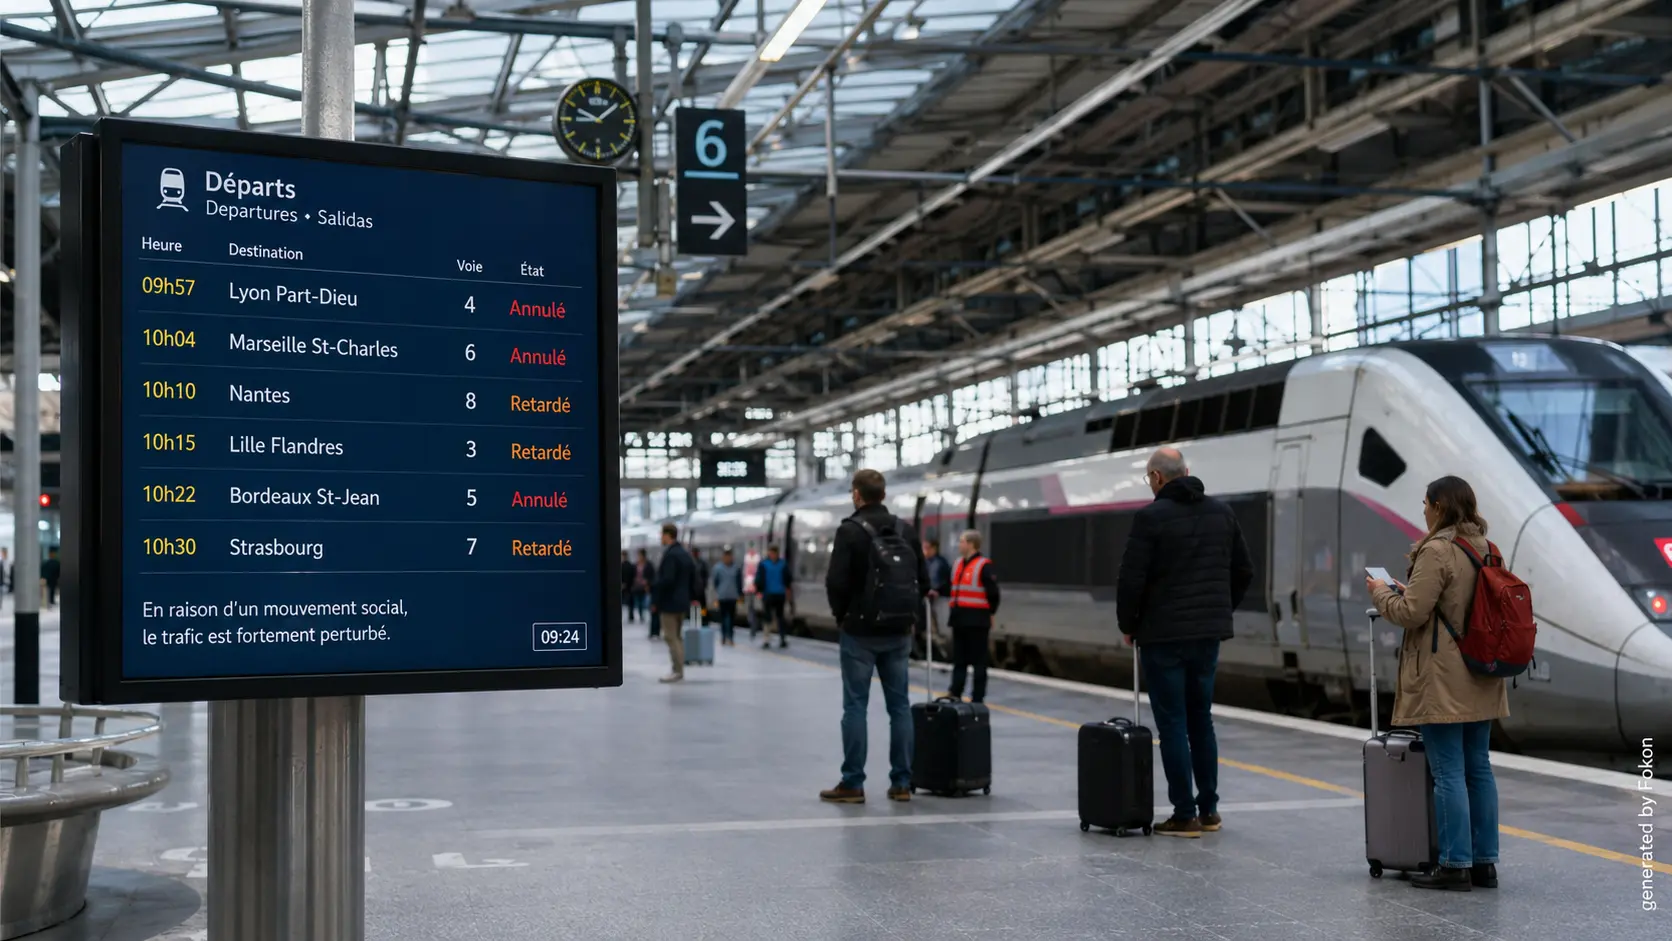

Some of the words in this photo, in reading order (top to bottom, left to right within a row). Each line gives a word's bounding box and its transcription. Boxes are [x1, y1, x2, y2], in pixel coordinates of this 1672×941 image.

[695, 119, 728, 168] 6
[205, 170, 296, 200] Départs
[206, 200, 298, 223] Departures
[317, 209, 374, 229] Salidas
[141, 236, 183, 253] Heure
[229, 242, 304, 261] Destination
[456, 258, 483, 273] Voie
[520, 260, 545, 278] État
[142, 276, 196, 296] 09h57
[229, 281, 271, 304] Lyon
[276, 285, 358, 307] Part-Dieu
[464, 295, 476, 314] 4
[509, 299, 566, 319] Annulé
[143, 328, 196, 348] 10h04
[229, 332, 307, 354] Marseille
[311, 337, 399, 358] St-Charles
[464, 343, 476, 362] 6
[509, 347, 567, 366] Annulé
[142, 380, 197, 400] 10h10
[229, 384, 291, 404] Nantes
[465, 391, 477, 410] 8
[510, 394, 571, 414] Retardé
[143, 432, 196, 452] 10h15
[230, 435, 266, 454] Lille
[271, 436, 344, 456] Flandres
[465, 440, 477, 458] 3
[511, 442, 572, 461] Retardé
[143, 484, 196, 503] 10h22
[230, 486, 312, 505] Bordeaux
[316, 487, 380, 506] St-Jean
[466, 488, 478, 507] 5
[511, 490, 568, 509] Annulé
[143, 537, 197, 556] 10h30
[229, 537, 324, 560] Strasbourg
[466, 537, 478, 556] 7
[512, 539, 572, 557] Retardé
[143, 601, 164, 618] En
[169, 601, 218, 618] raison
[223, 600, 259, 617] d’un
[263, 600, 358, 617] mouvement
[361, 598, 408, 617] social,
[143, 628, 158, 646] le
[160, 627, 204, 645] trafic
[207, 628, 233, 644] est
[236, 626, 316, 644] fortement
[320, 624, 391, 646] perturbé.
[540, 629, 580, 645] 09:24
